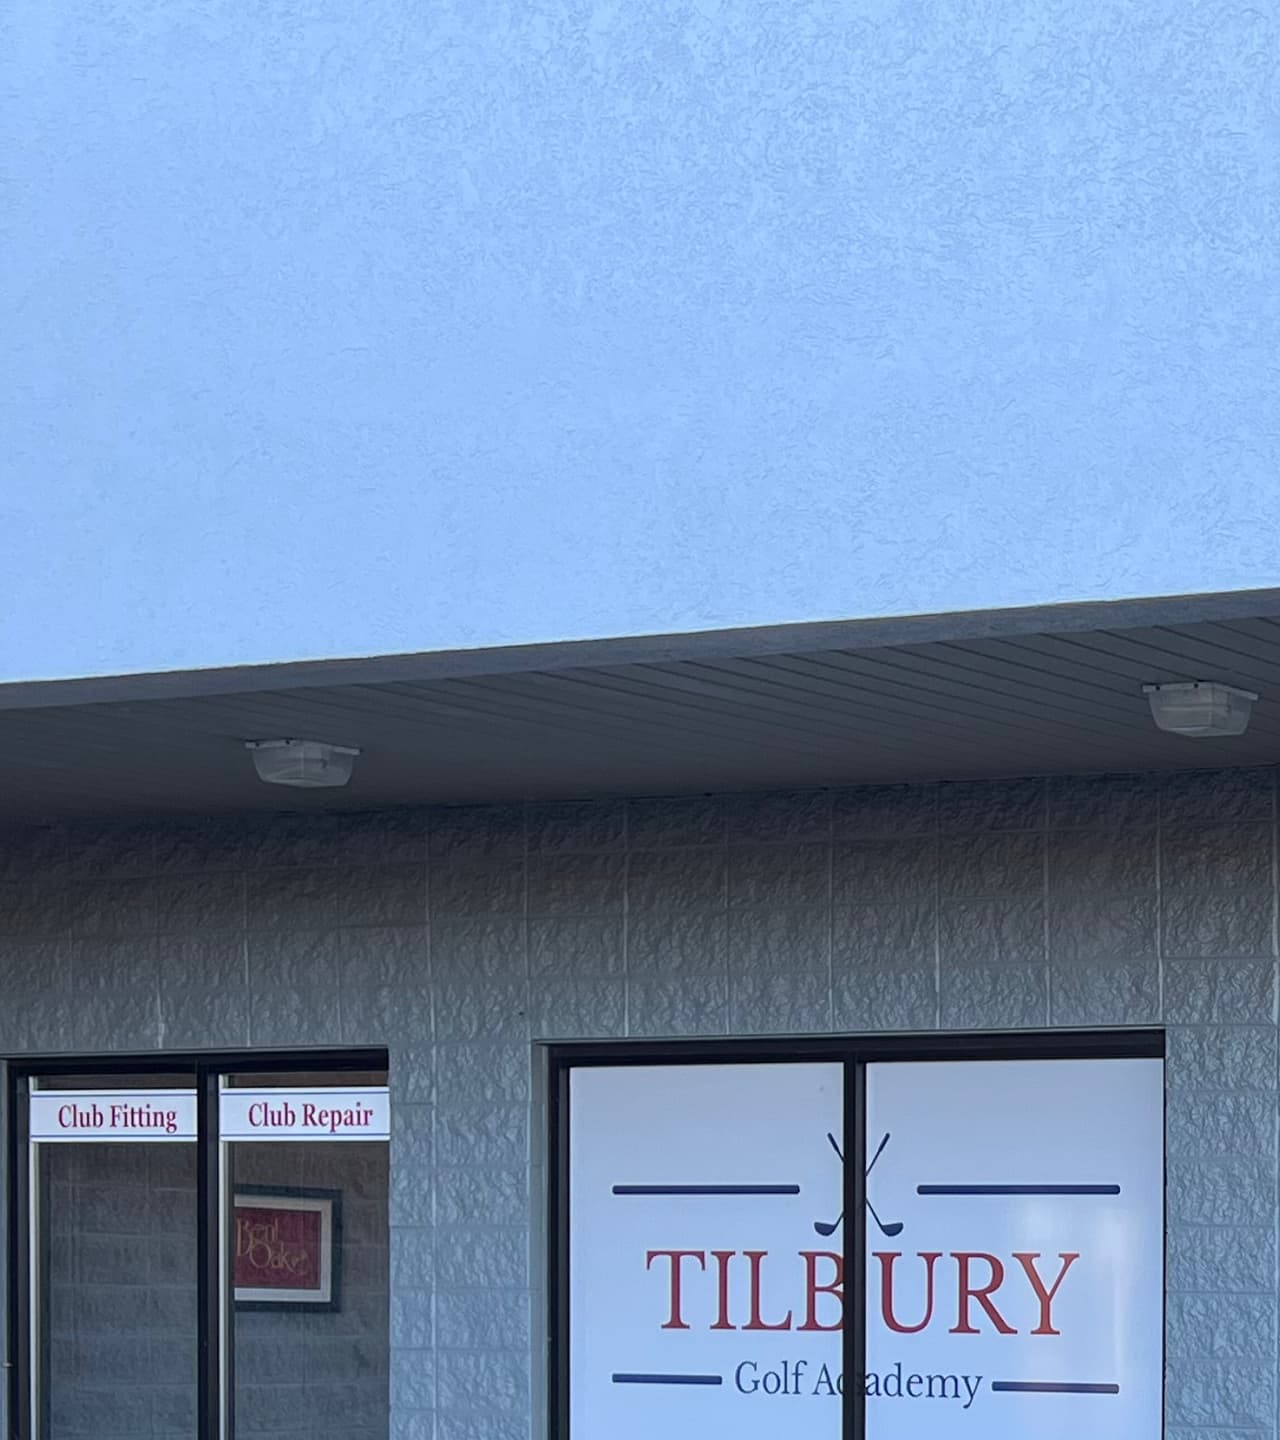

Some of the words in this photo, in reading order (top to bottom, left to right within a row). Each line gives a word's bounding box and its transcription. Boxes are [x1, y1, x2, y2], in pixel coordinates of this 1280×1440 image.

[58, 1104, 104, 1128] Club
[109, 1104, 177, 1134] Fitting
[248, 1103, 296, 1127] Club
[301, 1102, 374, 1133] Repair
[646, 1250, 1081, 1336] TILBURY
[735, 1360, 808, 1395] Golf
[812, 1361, 984, 1409] Academy
